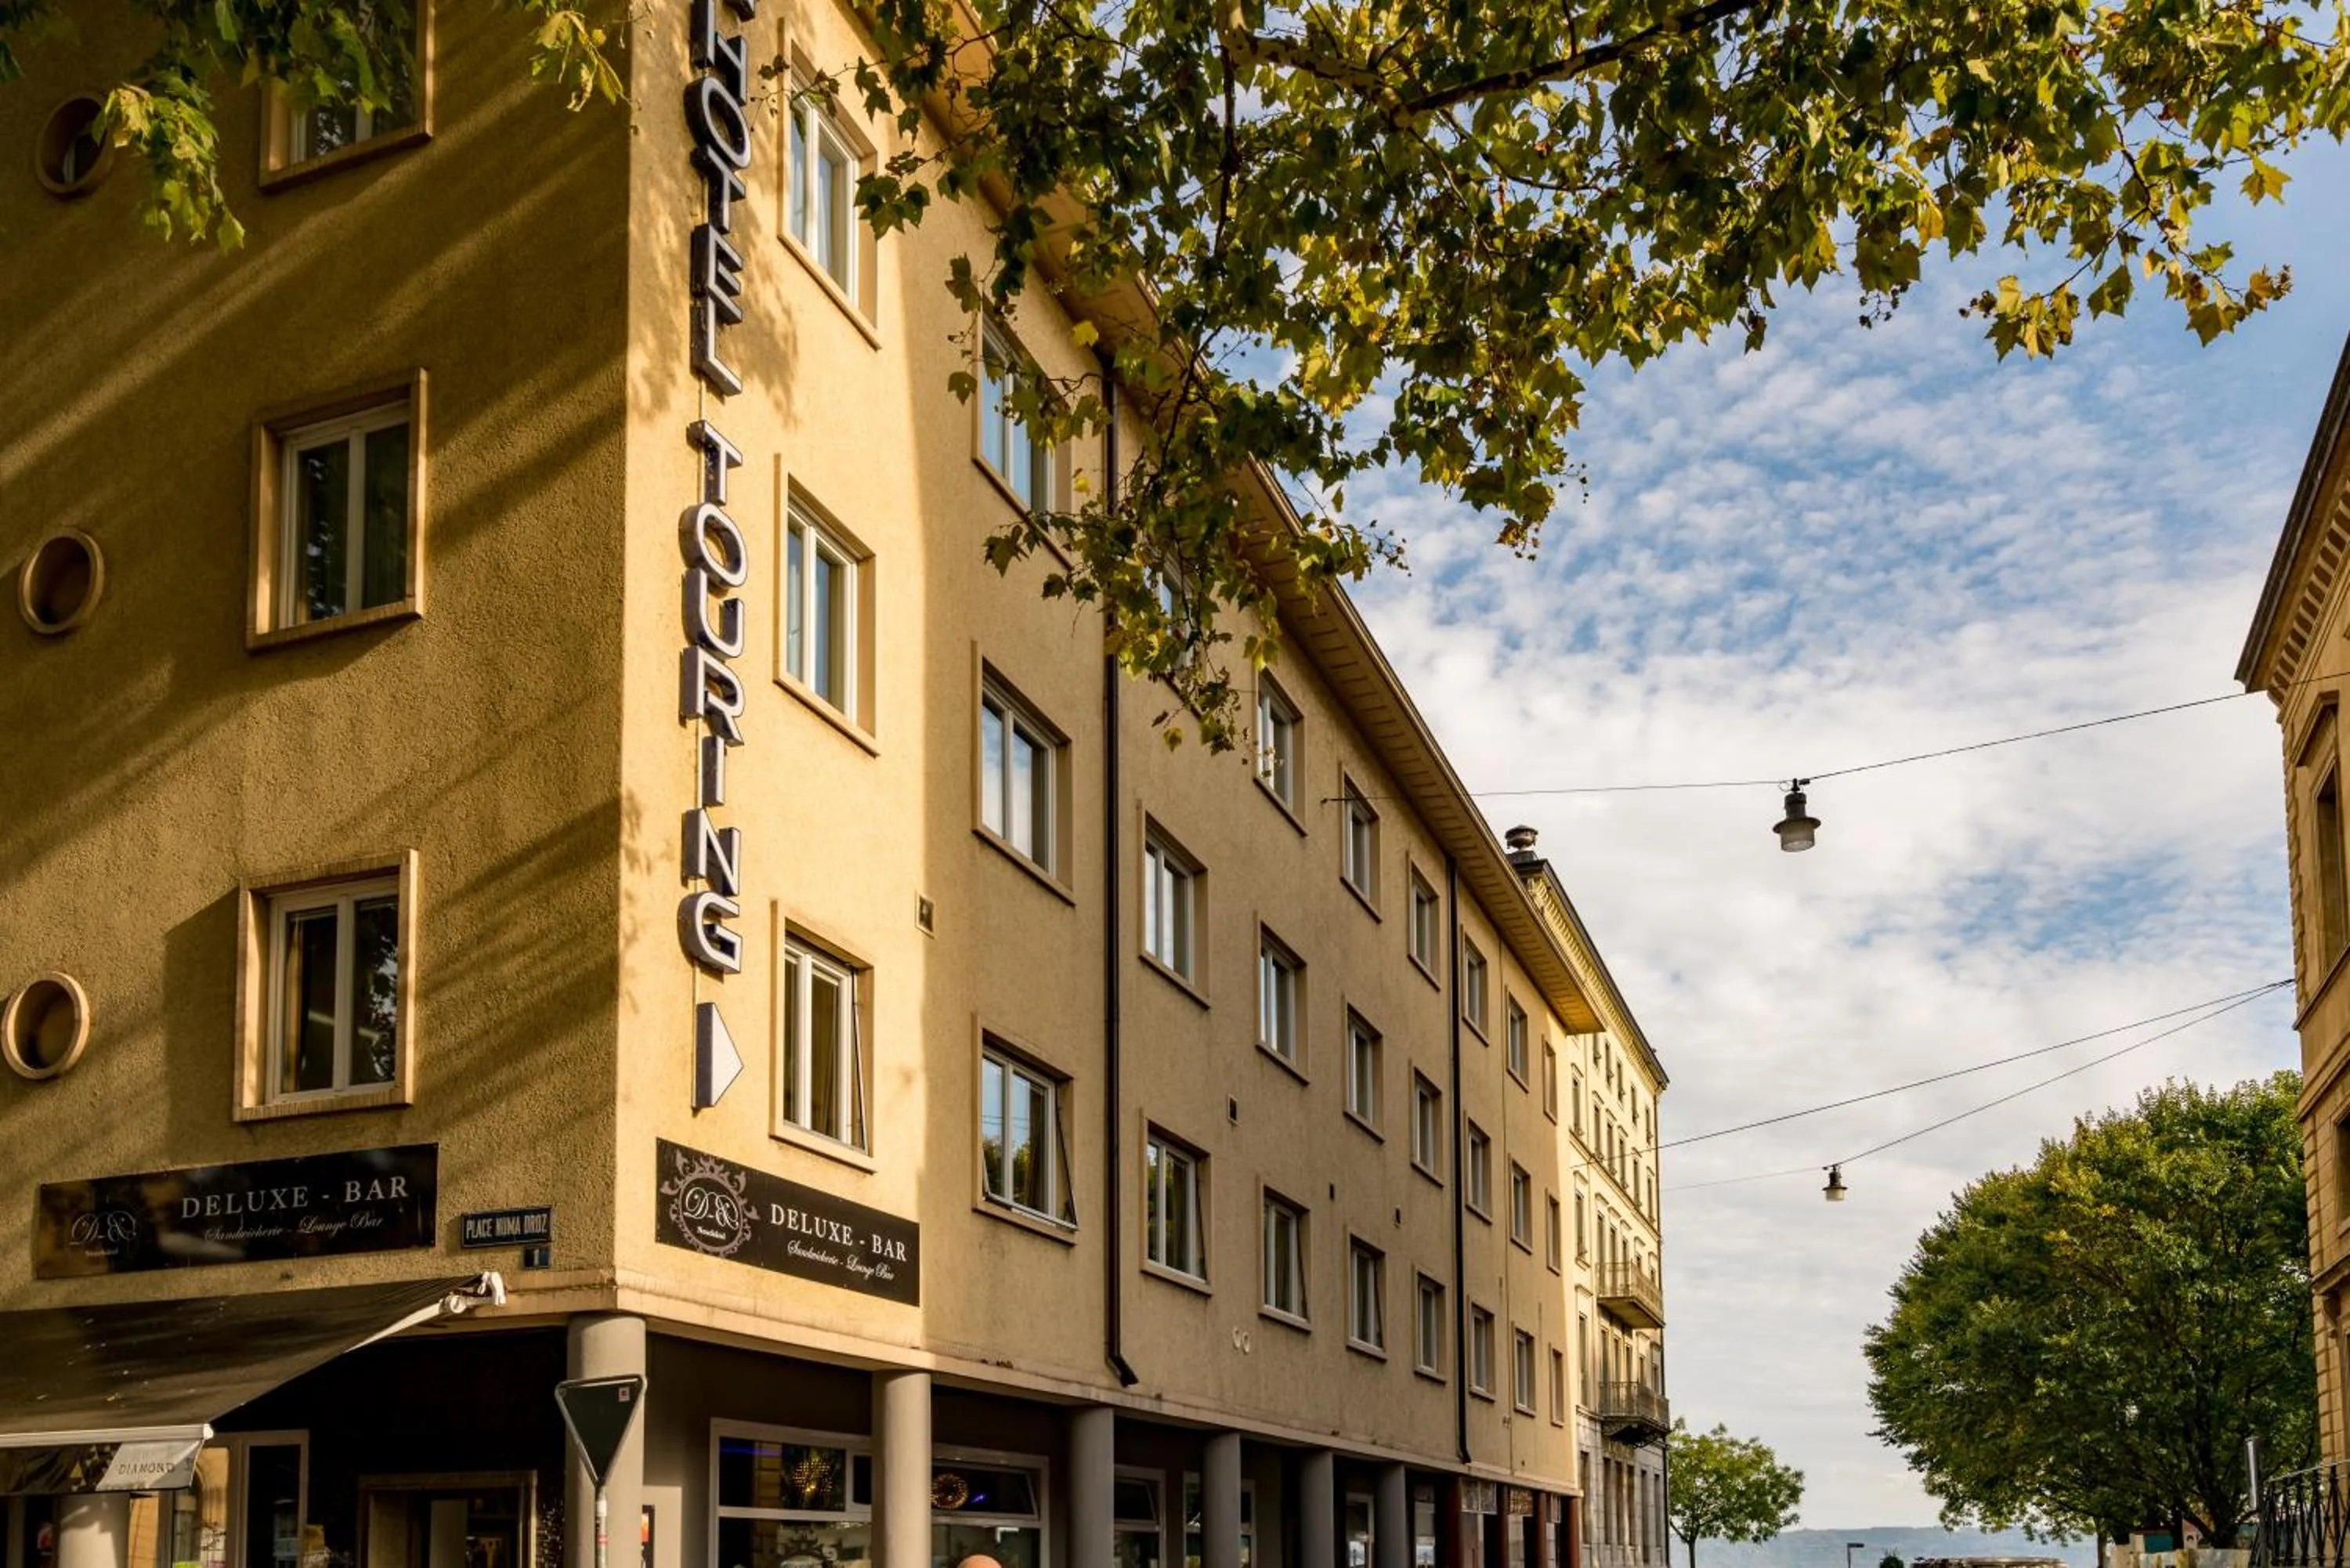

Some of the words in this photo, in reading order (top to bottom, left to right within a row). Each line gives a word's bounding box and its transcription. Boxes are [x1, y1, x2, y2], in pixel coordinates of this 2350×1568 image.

[683, 0, 752, 399] HOTEL
[678, 419, 748, 975] TOURING
[181, 1185, 309, 1219] DELUXE
[343, 1176, 409, 1203] BAR
[295, 1215, 347, 1236] Lounge
[349, 1212, 385, 1230] Bar
[465, 1218, 494, 1241] PLACE
[495, 1215, 522, 1237] NUMA
[523, 1213, 548, 1234] DROZ
[770, 1202, 853, 1247] DELUXE
[871, 1233, 908, 1263] BAR
[875, 1261, 895, 1281] Bar
[118, 1461, 176, 1476] DIAMOND
